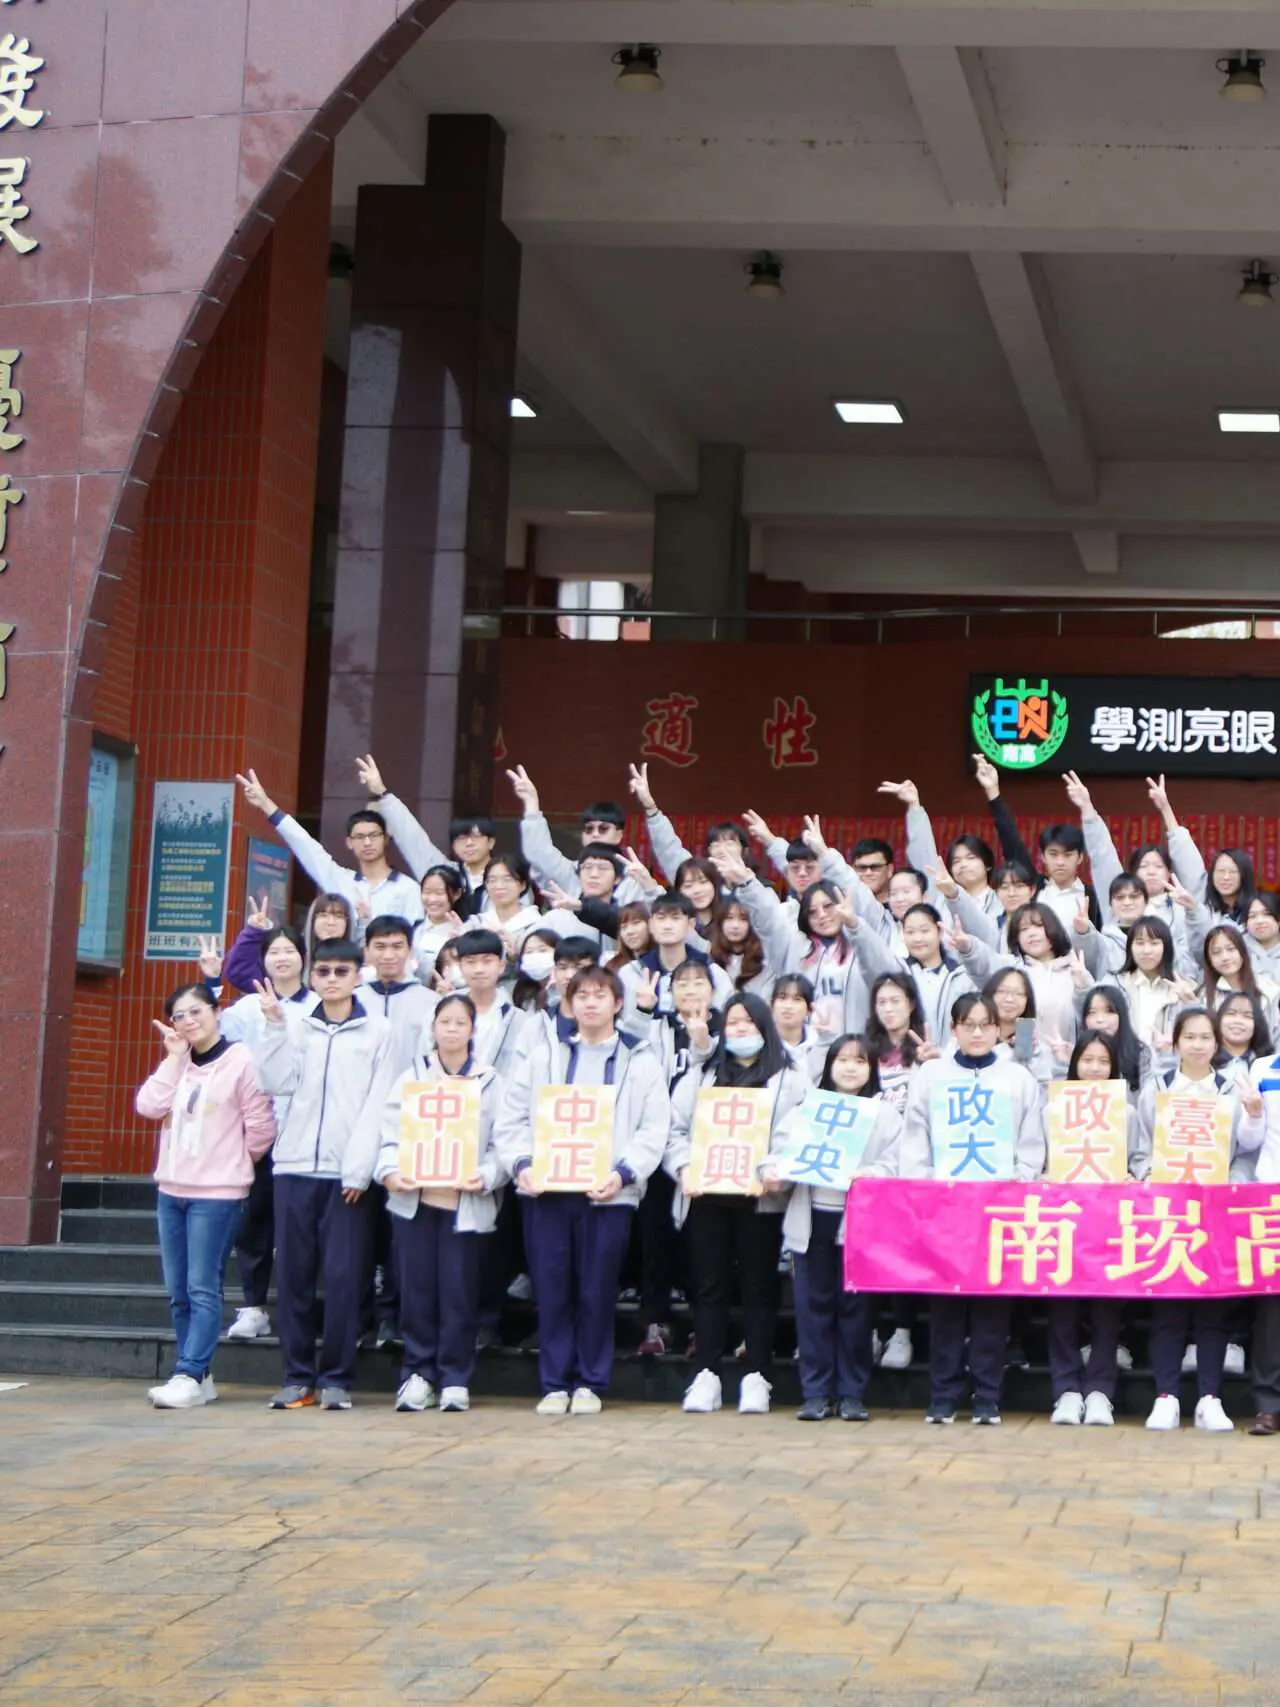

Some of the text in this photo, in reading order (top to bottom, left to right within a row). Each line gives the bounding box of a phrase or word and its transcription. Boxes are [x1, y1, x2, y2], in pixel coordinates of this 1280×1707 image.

[641, 692, 817, 768] 適性
[413, 1087, 462, 1182] 中山
[546, 1090, 597, 1183] 中正
[703, 1093, 754, 1186] 中興
[789, 1099, 859, 1183] 中央
[947, 1086, 997, 1177] 政大
[1063, 1087, 1114, 1183] 政大
[1166, 1098, 1217, 1183] 臺大
